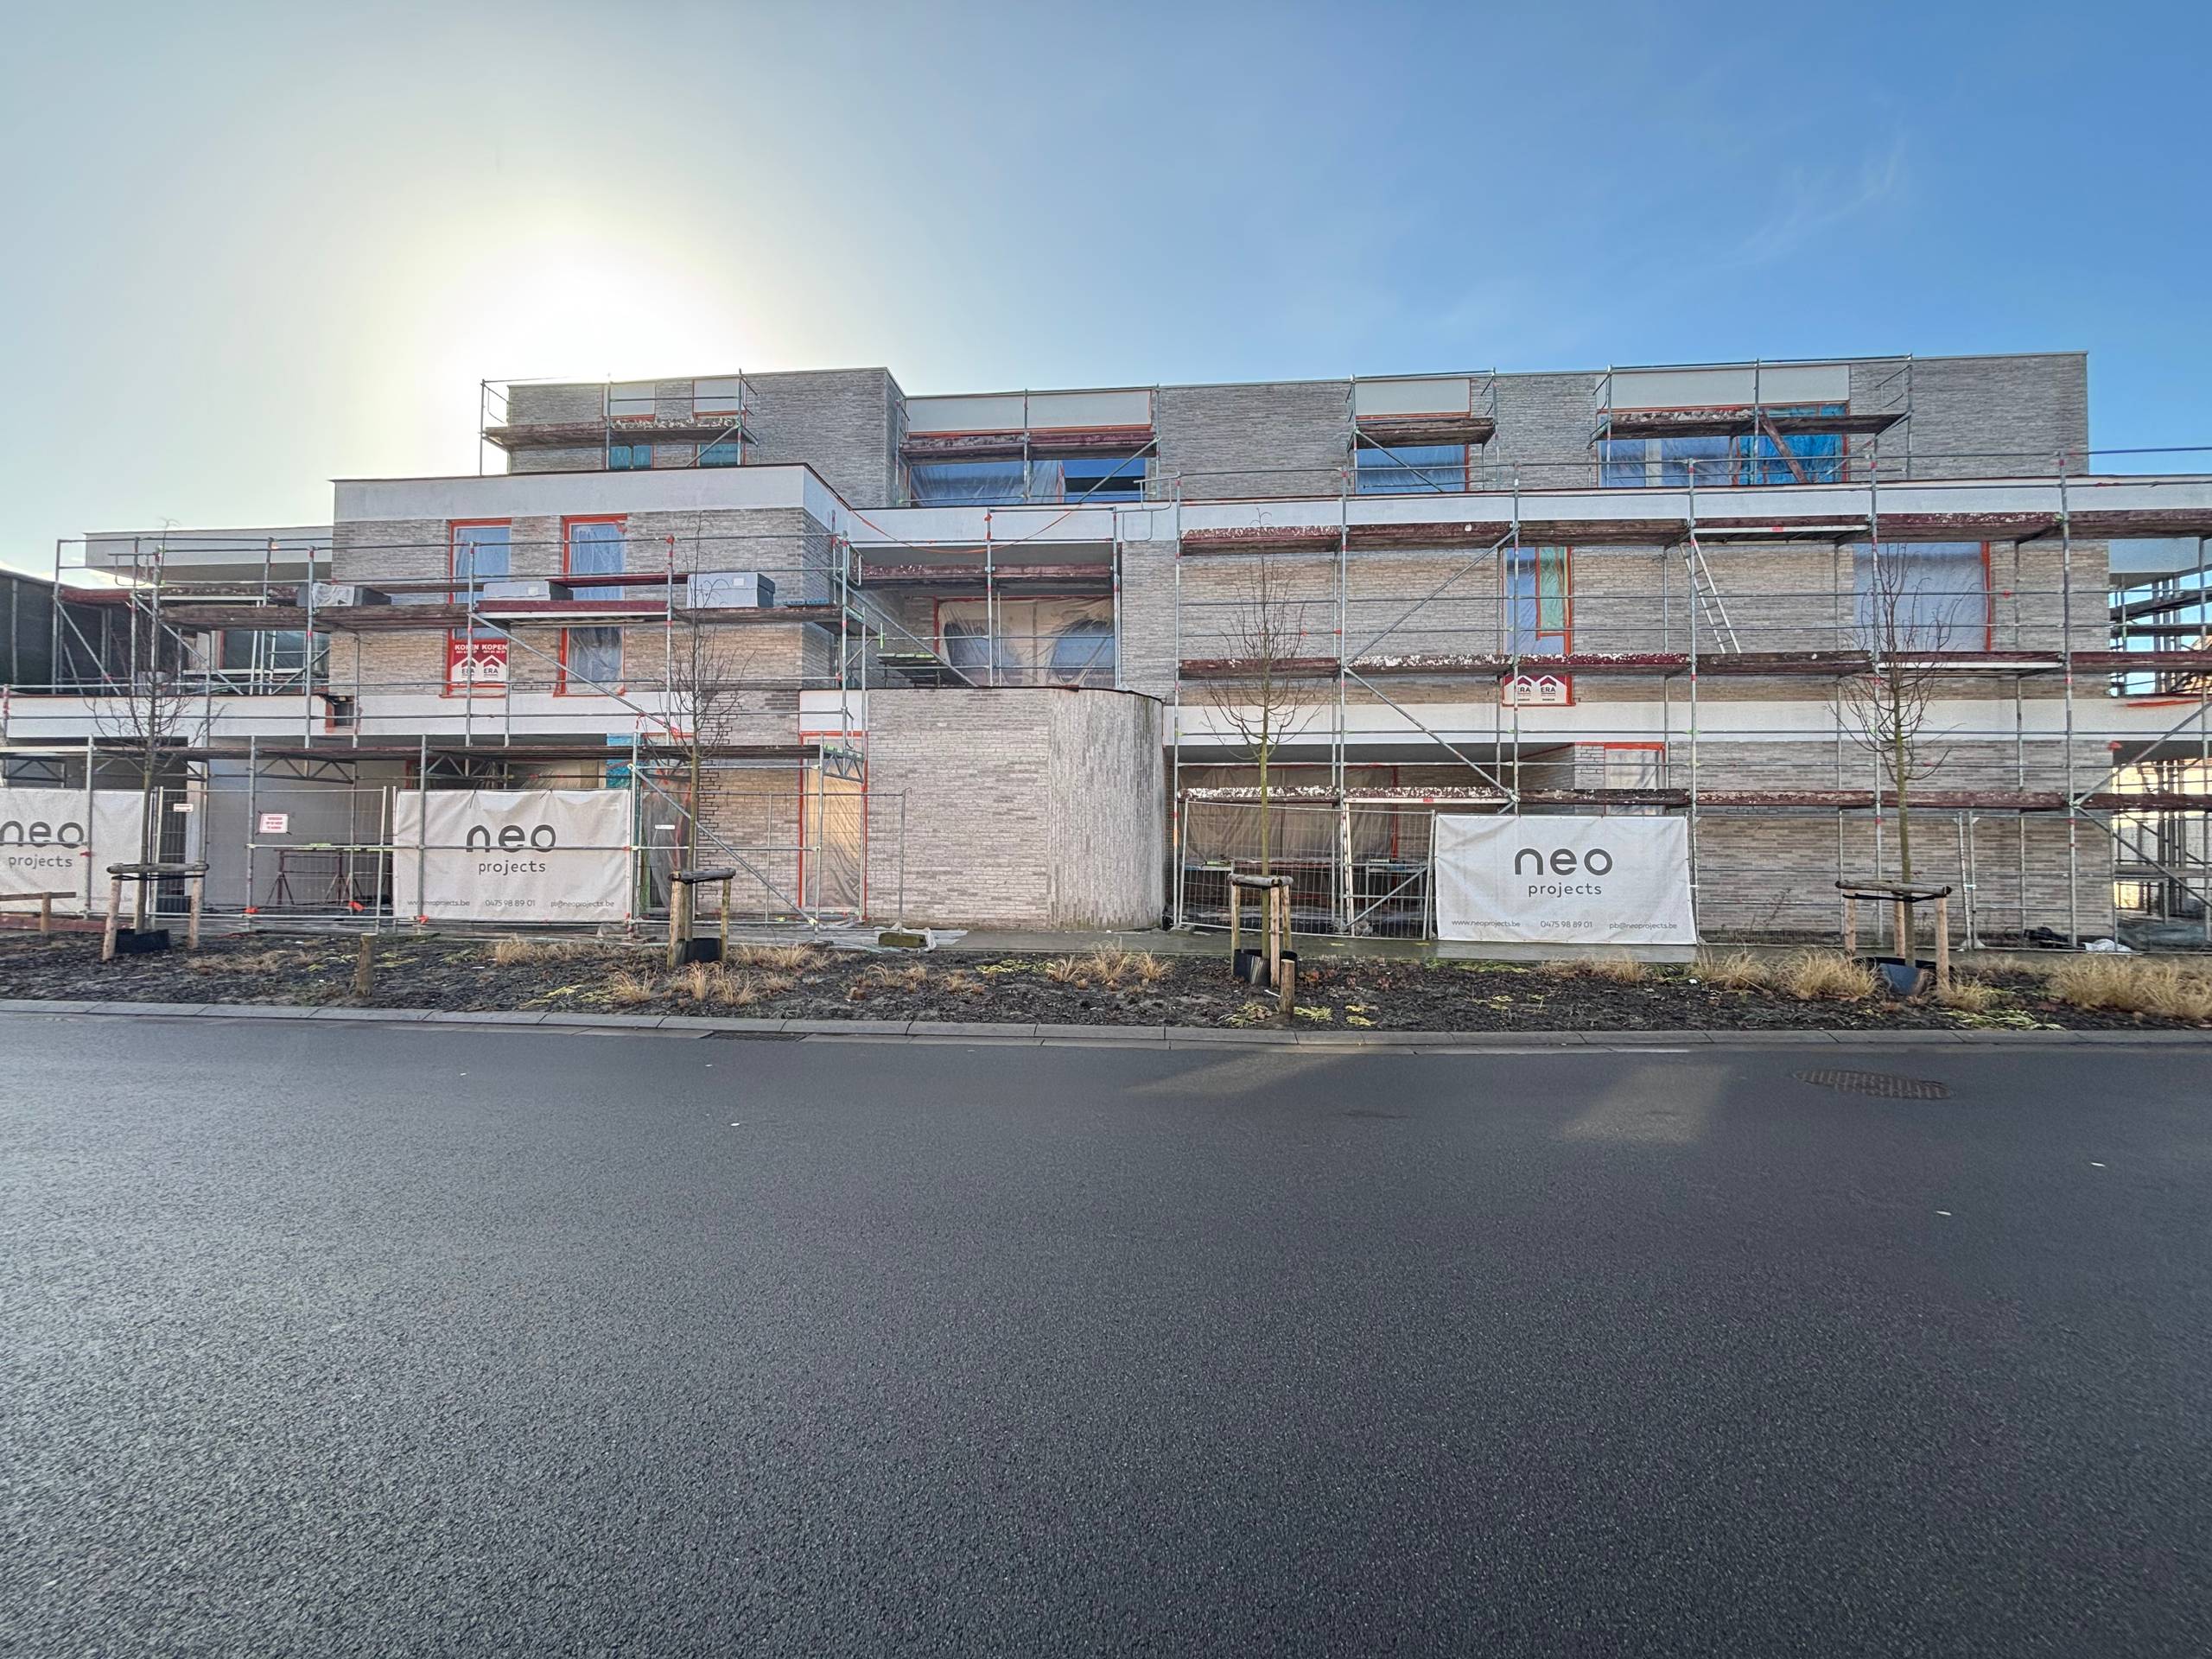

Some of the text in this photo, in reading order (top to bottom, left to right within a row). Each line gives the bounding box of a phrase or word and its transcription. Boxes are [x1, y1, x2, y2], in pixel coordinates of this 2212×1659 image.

[0, 820, 85, 849] neo
[466, 824, 556, 853] neo
[8, 854, 73, 869] projects
[478, 860, 546, 875] projects
[1514, 848, 1613, 876] neo
[1528, 881, 1602, 898] projects
[1451, 919, 1521, 928] www.neoprojects.be
